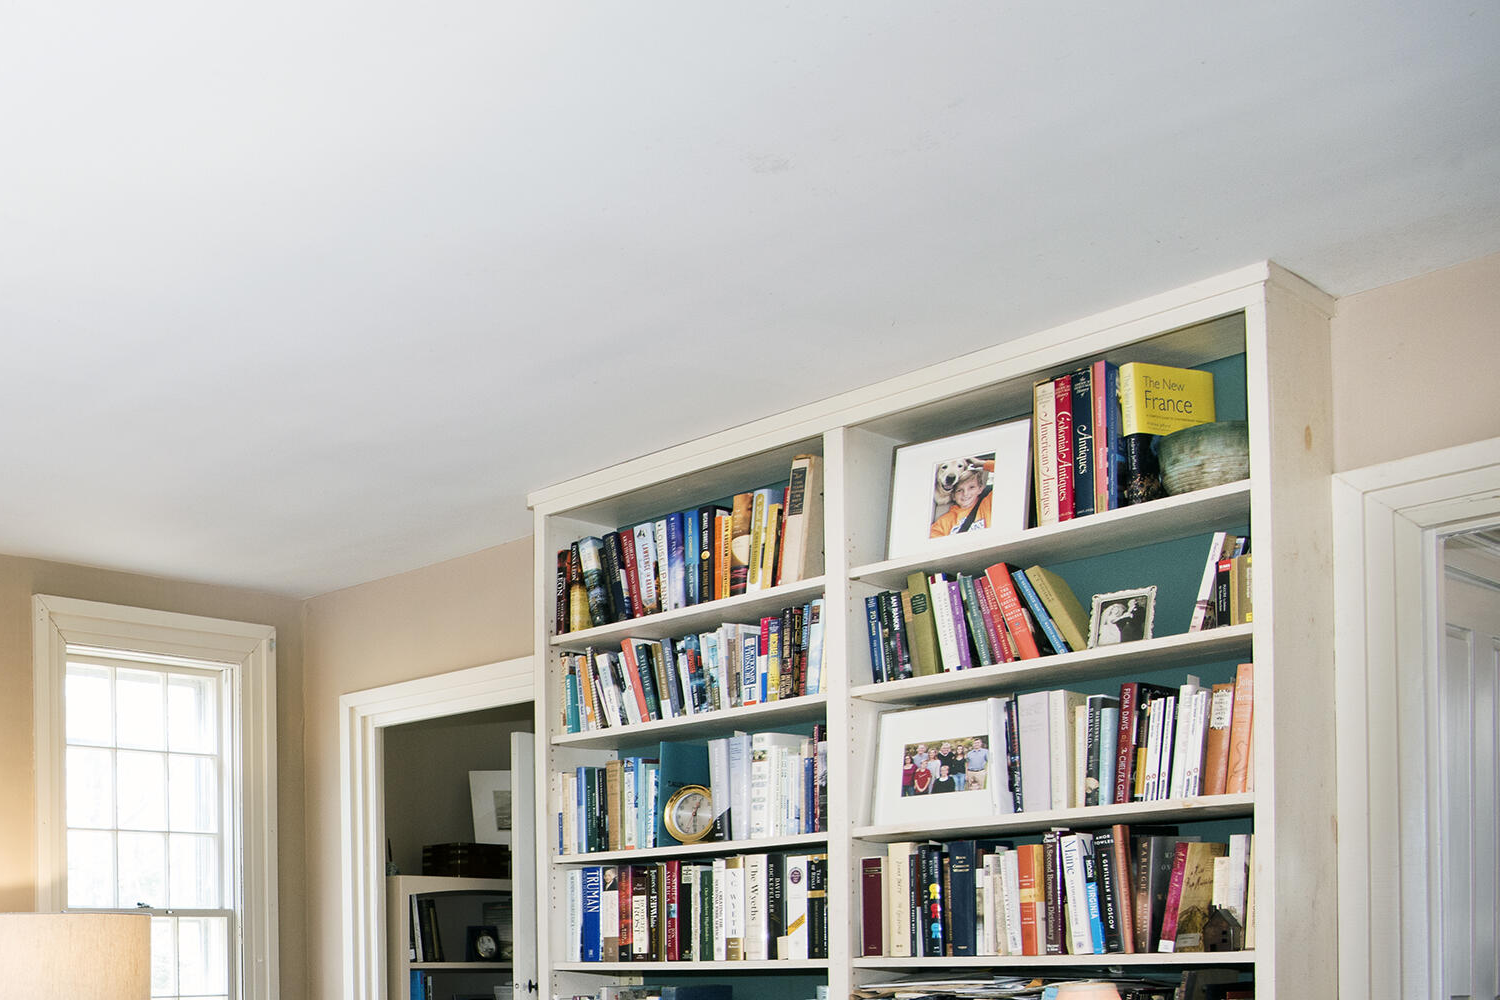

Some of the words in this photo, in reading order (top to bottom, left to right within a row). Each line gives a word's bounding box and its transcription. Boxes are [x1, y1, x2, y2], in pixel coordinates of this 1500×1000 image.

[1143, 376, 1159, 389] The
[1163, 378, 1185, 391] New
[1144, 390, 1193, 414] France
[1039, 412, 1053, 466] American
[1056, 411, 1071, 453] Colonial
[1076, 424, 1092, 474] Antiques
[1057, 453, 1072, 502] Antiques
[1041, 468, 1055, 516] Antiques
[641, 543, 650, 571] LAWRENCE
[657, 529, 665, 562] LOUISE
[644, 579, 653, 598] ARABIA
[660, 572, 668, 607] PENNY
[869, 620, 877, 636] James
[892, 608, 900, 631] RANKIN
[638, 654, 648, 674] STILL
[664, 646, 672, 662] david
[641, 676, 651, 691] LIFE
[1122, 688, 1130, 709] FIONA
[1121, 711, 1129, 730] DAVIS
[1118, 756, 1126, 782] CHELSEA
[1116, 784, 1125, 802] GIRLS
[1064, 840, 1077, 875] Maine
[1140, 841, 1148, 896] WARLIGHT
[750, 864, 758, 882] The
[586, 870, 599, 912] TRUMAN
[748, 885, 758, 921] Wyeths
[1088, 884, 1098, 920] VIRGINIA
[1102, 859, 1111, 892] GENTLEMAN
[1107, 903, 1115, 929] MOSCOW
